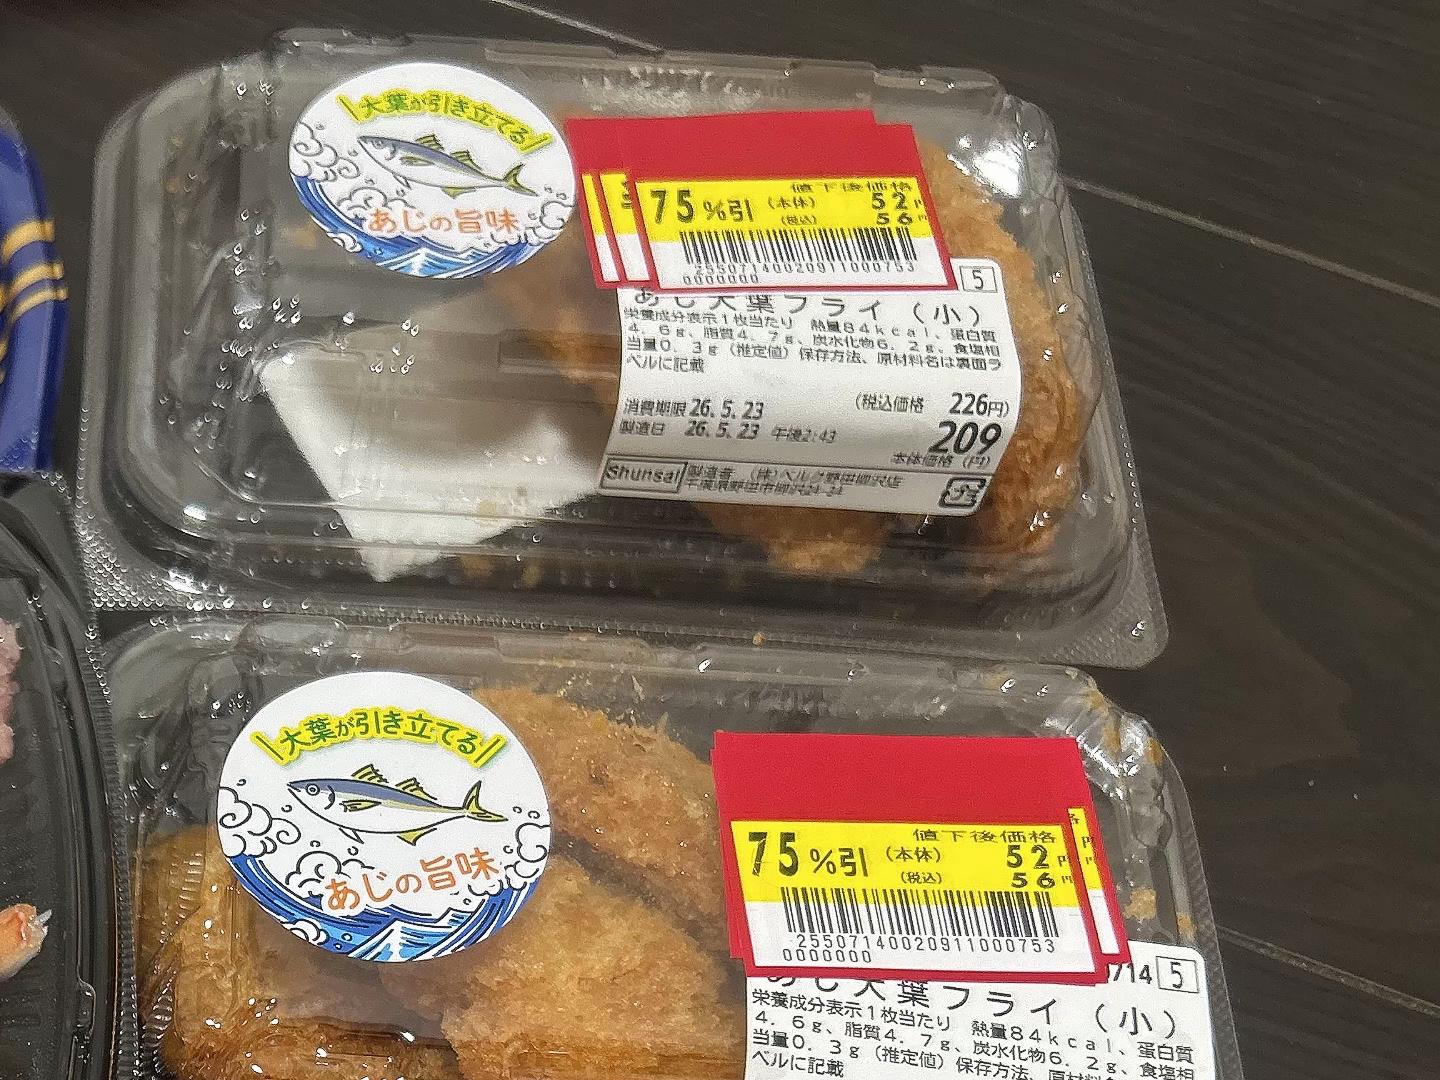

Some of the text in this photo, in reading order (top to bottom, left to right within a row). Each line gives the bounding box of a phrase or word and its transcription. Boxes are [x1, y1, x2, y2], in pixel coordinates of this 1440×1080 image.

[361, 92, 531, 145] 大葉が引き立てる
[367, 208, 522, 236] あじの旨味
[683, 275, 760, 286] 0000000
[971, 269, 985, 290] 5
[623, 398, 687, 418] 消費期限
[927, 420, 1003, 455] 209
[280, 708, 478, 755] 大葉が引き立てる
[912, 828, 1057, 845] 値下後価格
[747, 831, 869, 877] 75%引
[884, 845, 944, 864] (本体)
[326, 847, 500, 911] あじの旨味
[900, 870, 943, 886] (税込)
[782, 948, 873, 964] 0000000
[797, 933, 1056, 954] 25507140020911000753
[1169, 961, 1185, 989] 5
[751, 988, 951, 1032] 栄養成分表示1枚当たり
[751, 1050, 845, 1079] ベルに記載
